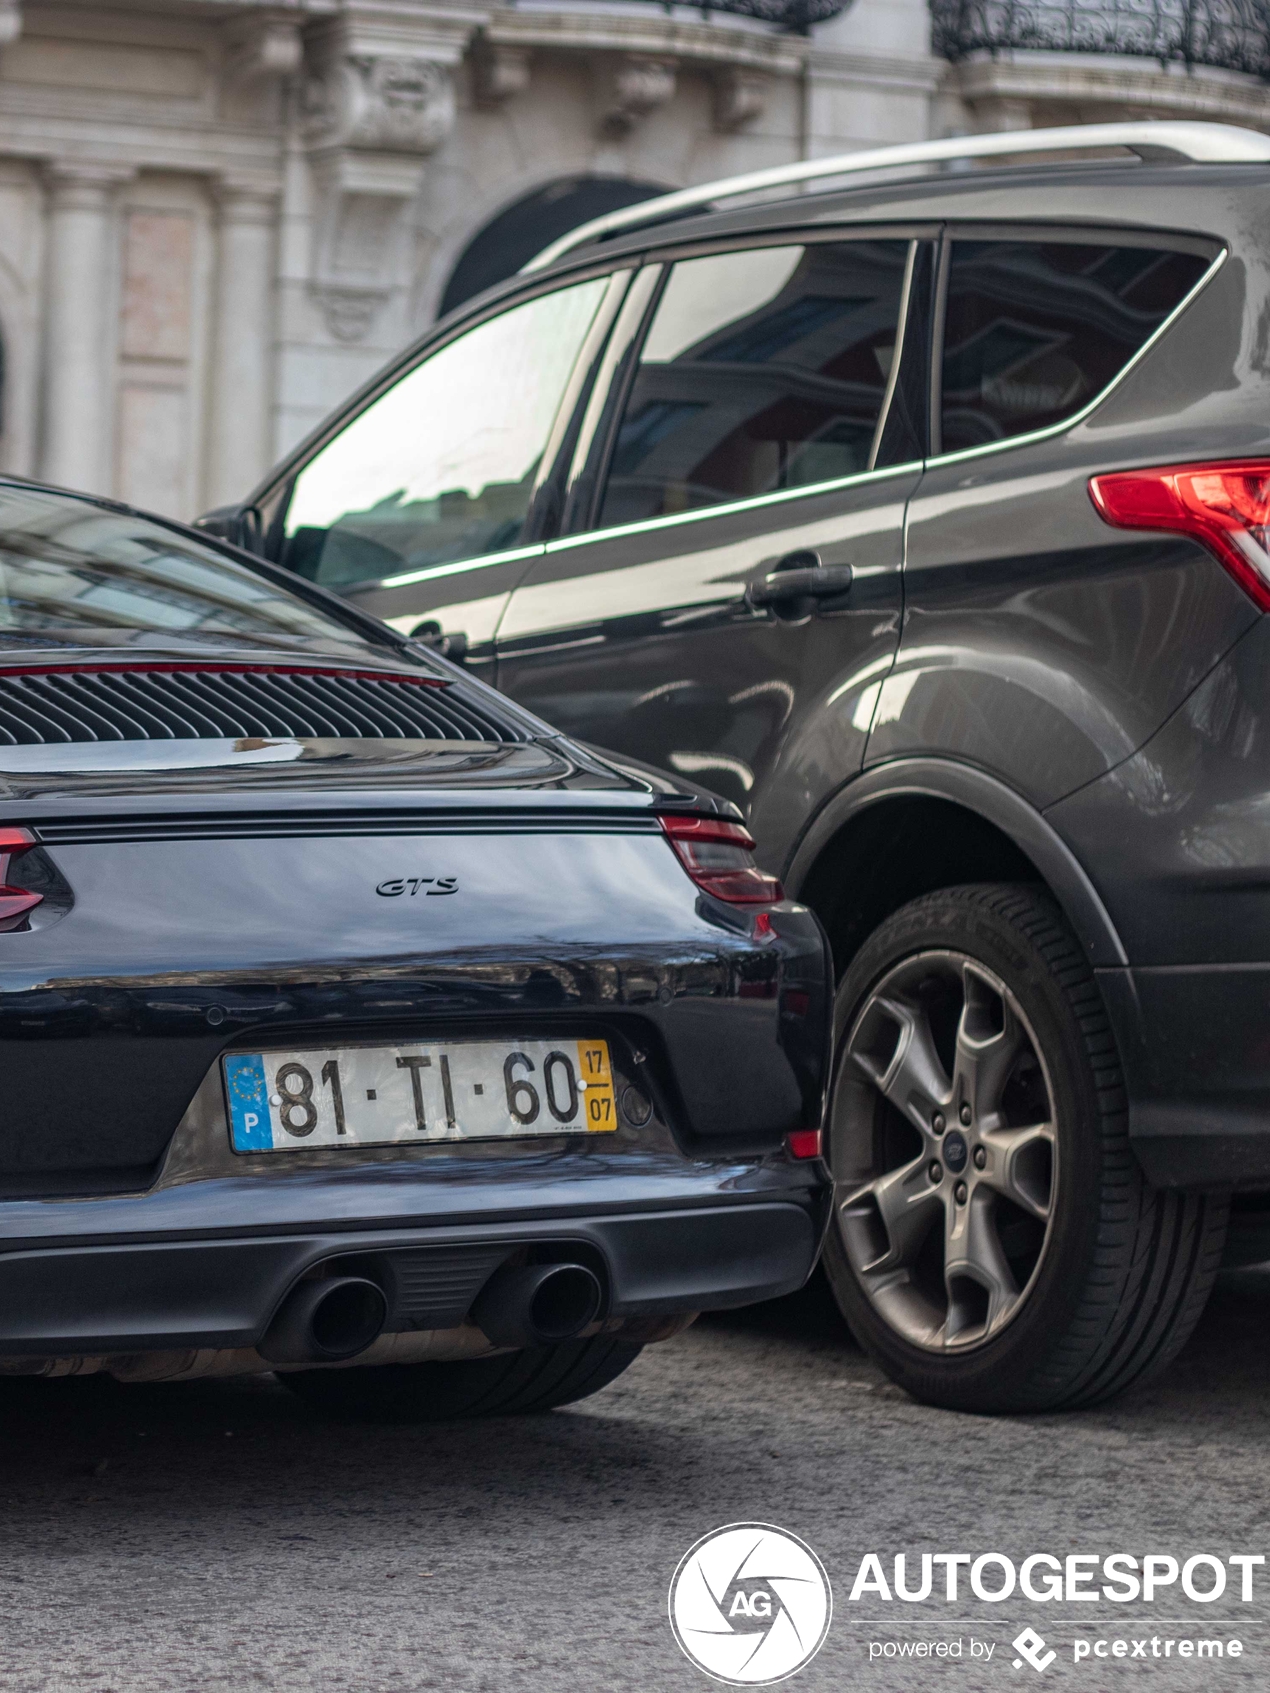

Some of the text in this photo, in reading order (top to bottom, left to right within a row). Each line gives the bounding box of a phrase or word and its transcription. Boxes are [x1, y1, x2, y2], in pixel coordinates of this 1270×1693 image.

[376, 877, 459, 897] GTS
[586, 1050, 603, 1074] 17
[590, 1097, 612, 1122] 07
[244, 1112, 259, 1134] P
